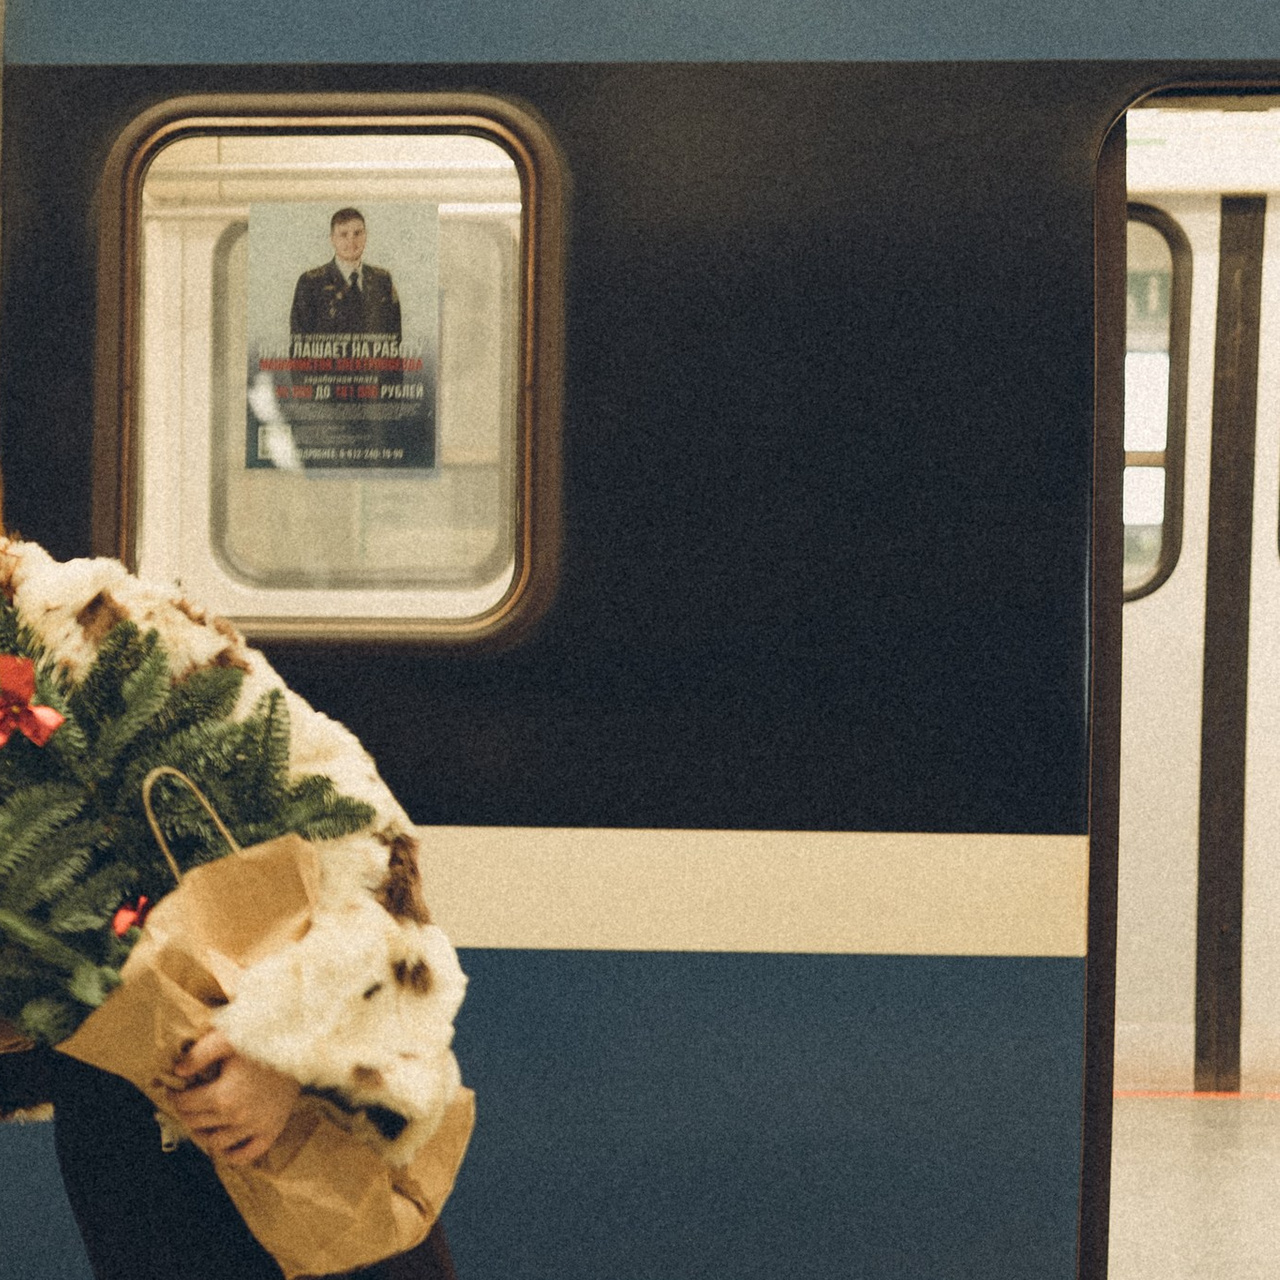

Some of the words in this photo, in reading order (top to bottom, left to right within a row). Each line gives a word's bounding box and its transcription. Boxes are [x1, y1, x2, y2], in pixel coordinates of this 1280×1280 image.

[351, 342, 370, 358] НА
[315, 385, 331, 400] ДО
[380, 383, 424, 399] РУБЛЕЙ
